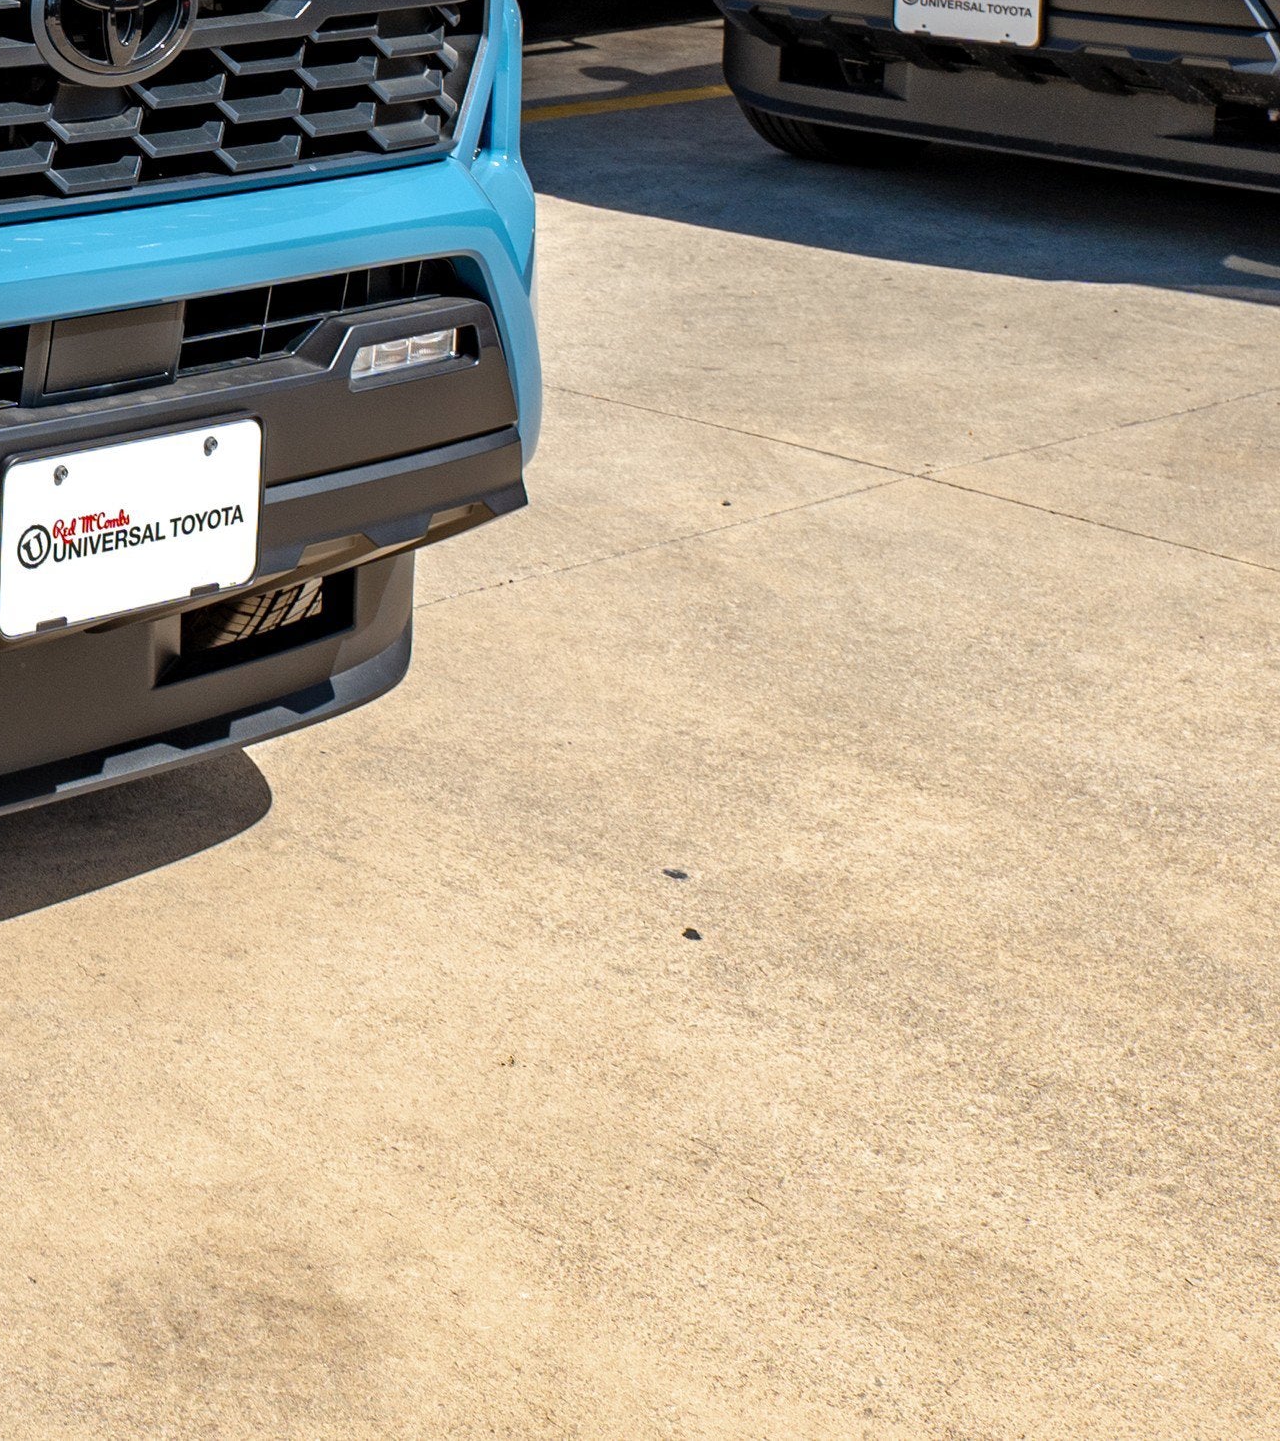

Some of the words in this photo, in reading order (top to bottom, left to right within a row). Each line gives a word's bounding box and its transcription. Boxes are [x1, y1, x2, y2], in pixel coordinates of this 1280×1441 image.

[987, 4, 1032, 18] TOYOTA
[52, 518, 78, 544] Red
[52, 522, 166, 562] UNIVERSAL
[170, 504, 244, 538] TOYOTA
